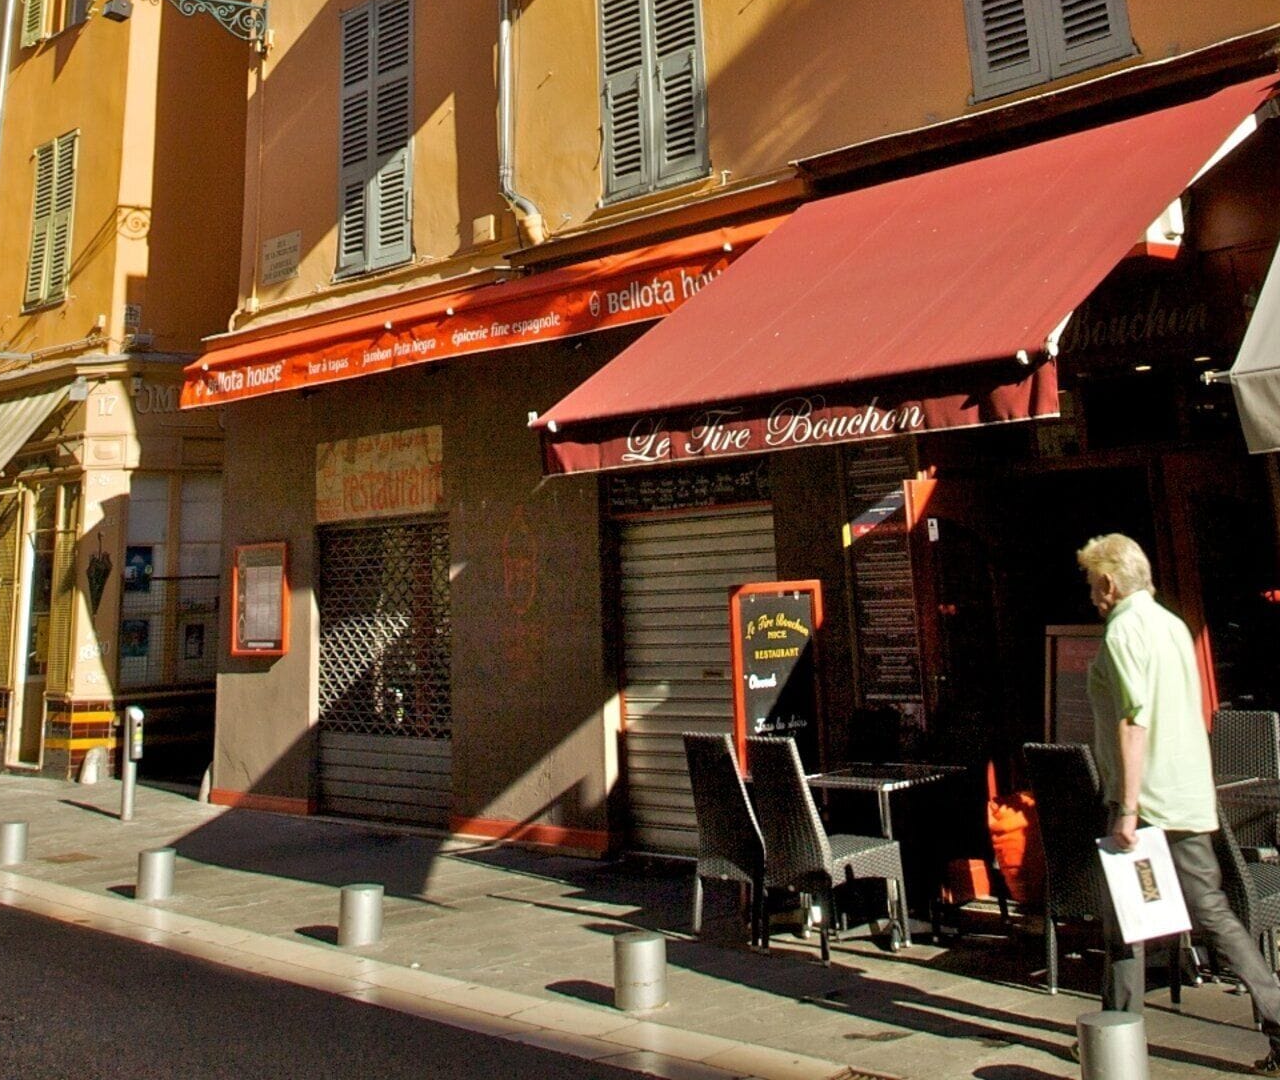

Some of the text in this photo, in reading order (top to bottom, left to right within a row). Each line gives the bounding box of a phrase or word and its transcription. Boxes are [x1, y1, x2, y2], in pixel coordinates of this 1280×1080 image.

[607, 277, 675, 314] Bellota
[451, 311, 561, 346] épicerie fine espagnole
[363, 346, 392, 367] jambon
[412, 336, 437, 353] Negra
[247, 365, 282, 387] house
[308, 361, 321, 374] bar
[328, 356, 349, 371] tapas
[621, 394, 926, 462] Le Tire Bouchon
[768, 630, 787, 639] NICE
[754, 648, 799, 659] RESTAURANT
